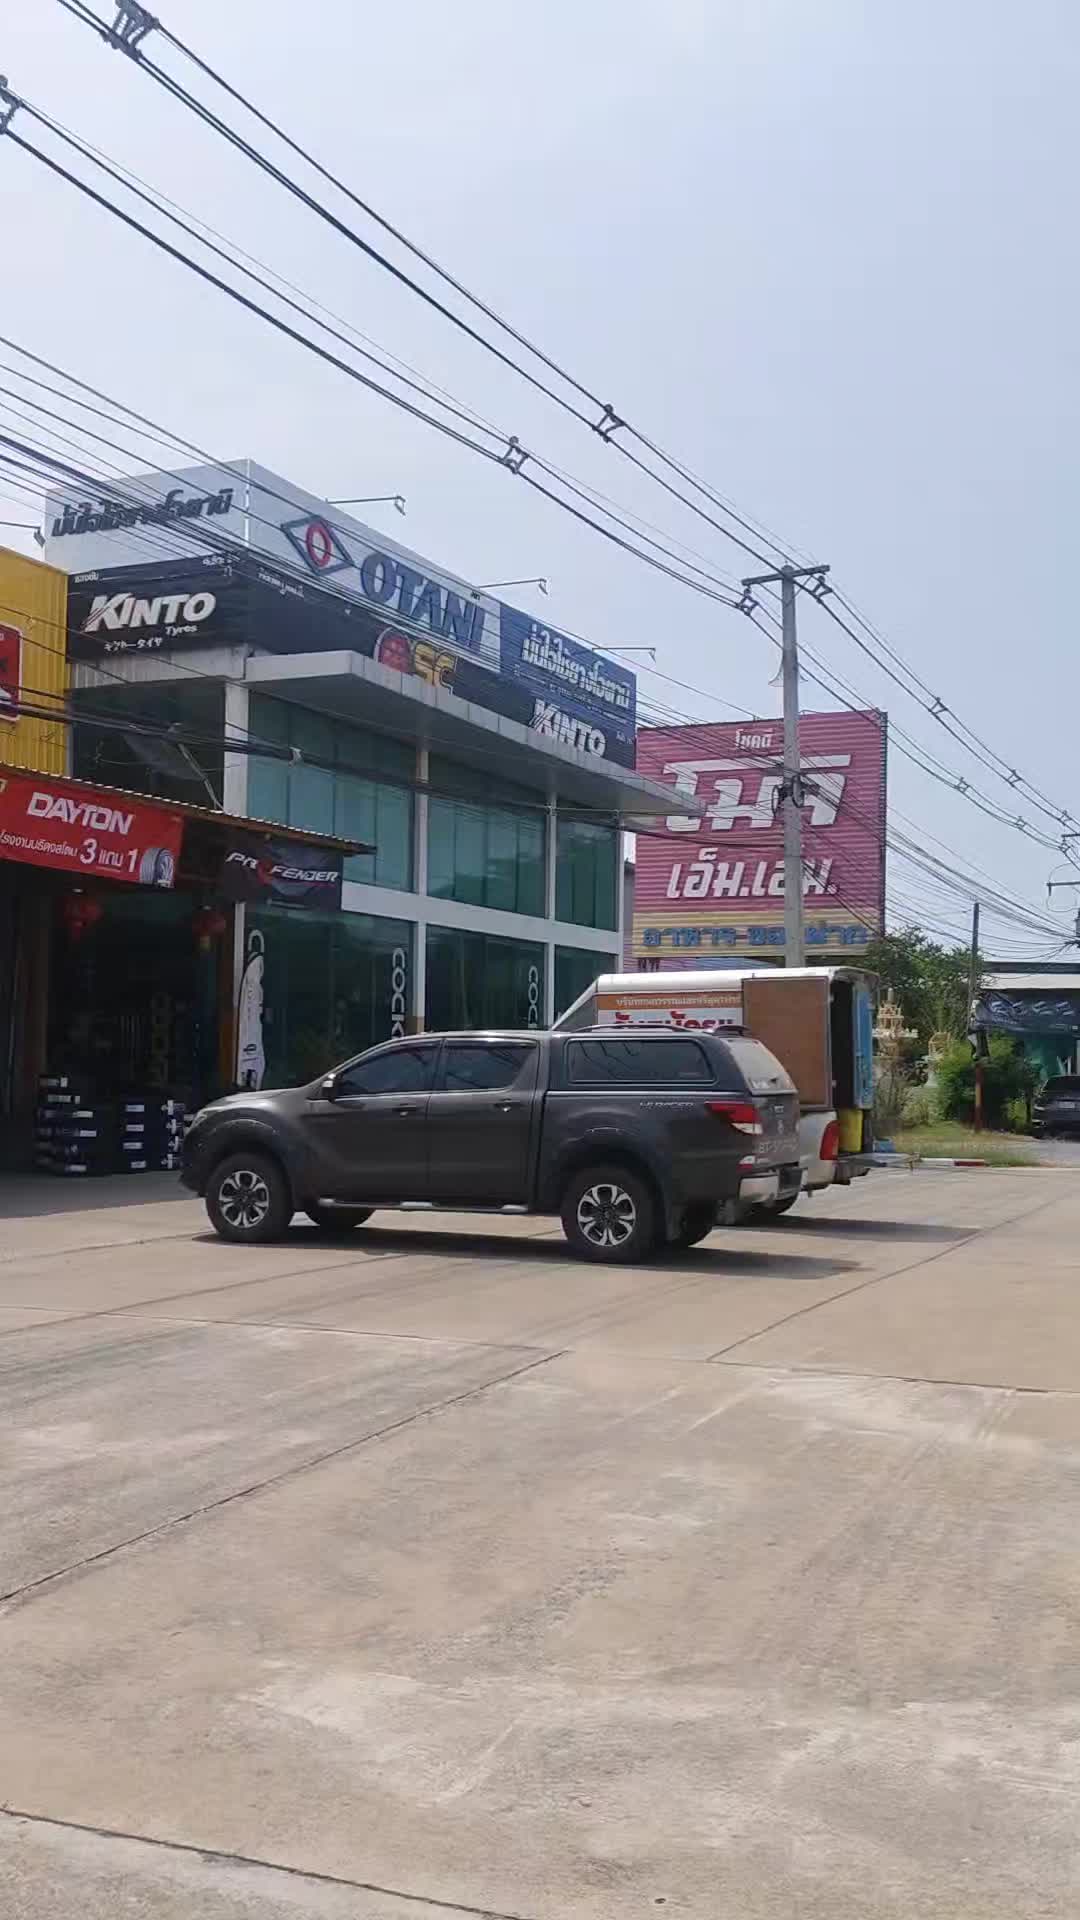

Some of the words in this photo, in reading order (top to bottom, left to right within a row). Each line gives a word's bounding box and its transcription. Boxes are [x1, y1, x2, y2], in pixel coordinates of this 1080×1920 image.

[80, 592, 217, 633] KINTO
[360, 553, 487, 655] OTANI
[165, 625, 198, 637] Tyres
[528, 698, 607, 758] KINTO
[26, 791, 136, 836] DAYTON
[80, 838, 97, 865] 3
[127, 848, 138, 873] 1
